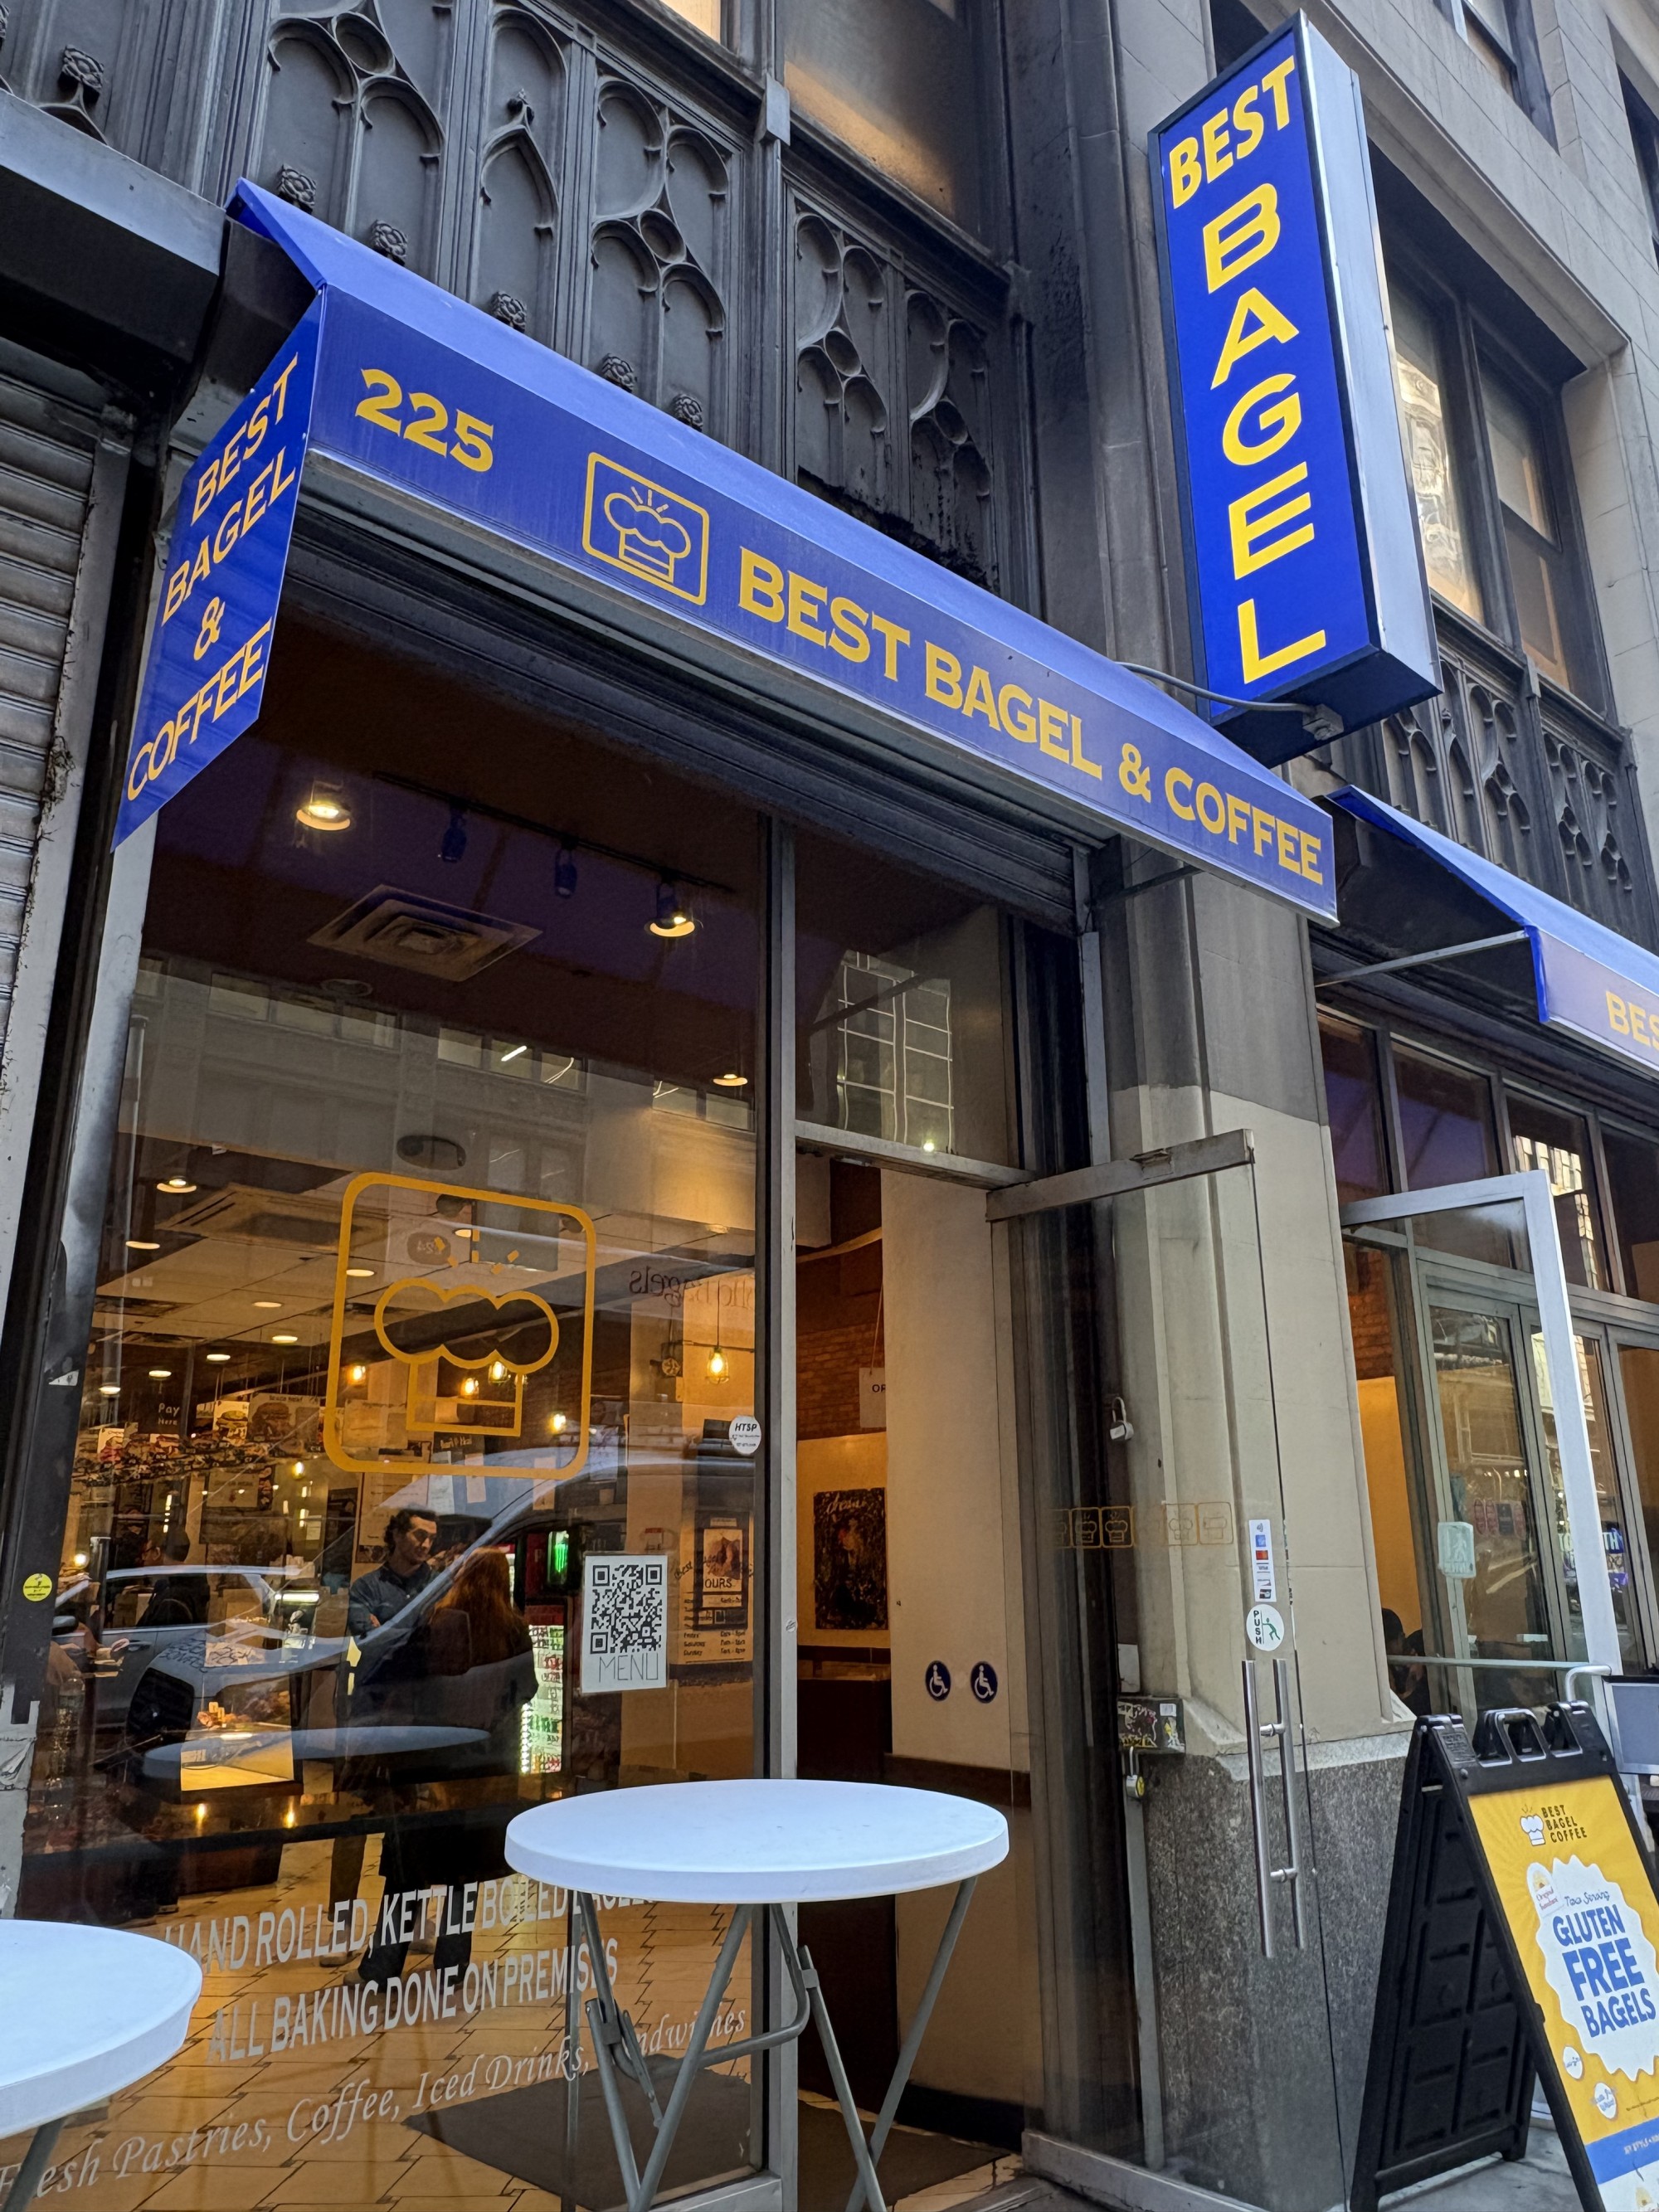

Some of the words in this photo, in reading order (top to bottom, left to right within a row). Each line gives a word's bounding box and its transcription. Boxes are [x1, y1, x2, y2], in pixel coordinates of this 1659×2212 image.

[1169, 55, 1297, 209] BEST
[192, 352, 299, 526] BEST
[356, 368, 495, 472] 225
[1203, 182, 1326, 683] BAGEL
[161, 448, 294, 628] BAGEL
[193, 596, 226, 661] &
[126, 618, 273, 802] COFFEE
[738, 547, 911, 682] BEST
[925, 641, 1102, 780] BAGEL
[1118, 742, 1151, 803] &
[1165, 766, 1324, 886] COFFEE
[158, 1403, 180, 1417] Pay
[1253, 1610, 1262, 1645] PUSH
[598, 1651, 659, 1683] MENU
[1541, 1804, 1566, 1819] BEST
[1545, 1816, 1578, 1831] BAGEL
[1550, 1826, 1588, 1843] COFFEE
[255, 1898, 376, 1967] ROLLED,
[380, 1880, 478, 1947] KETTLE
[1552, 1904, 1626, 1947] GLUTEN
[208, 2001, 264, 2063] ALL
[270, 1979, 379, 2053] BAKING
[383, 1965, 459, 2030] DONE
[462, 1954, 499, 2015] ON
[502, 1937, 619, 2007] PREMISS
[1562, 1937, 1645, 2001] FREE
[1580, 1988, 1657, 2038] BAGELS
[0, 2138, 104, 2199] Fesh
[113, 2117, 272, 2180] Pastries,
[286, 2077, 401, 2146] Coffee,
[411, 2054, 485, 2109] Iced
[485, 2035, 590, 2091] Drinks,
